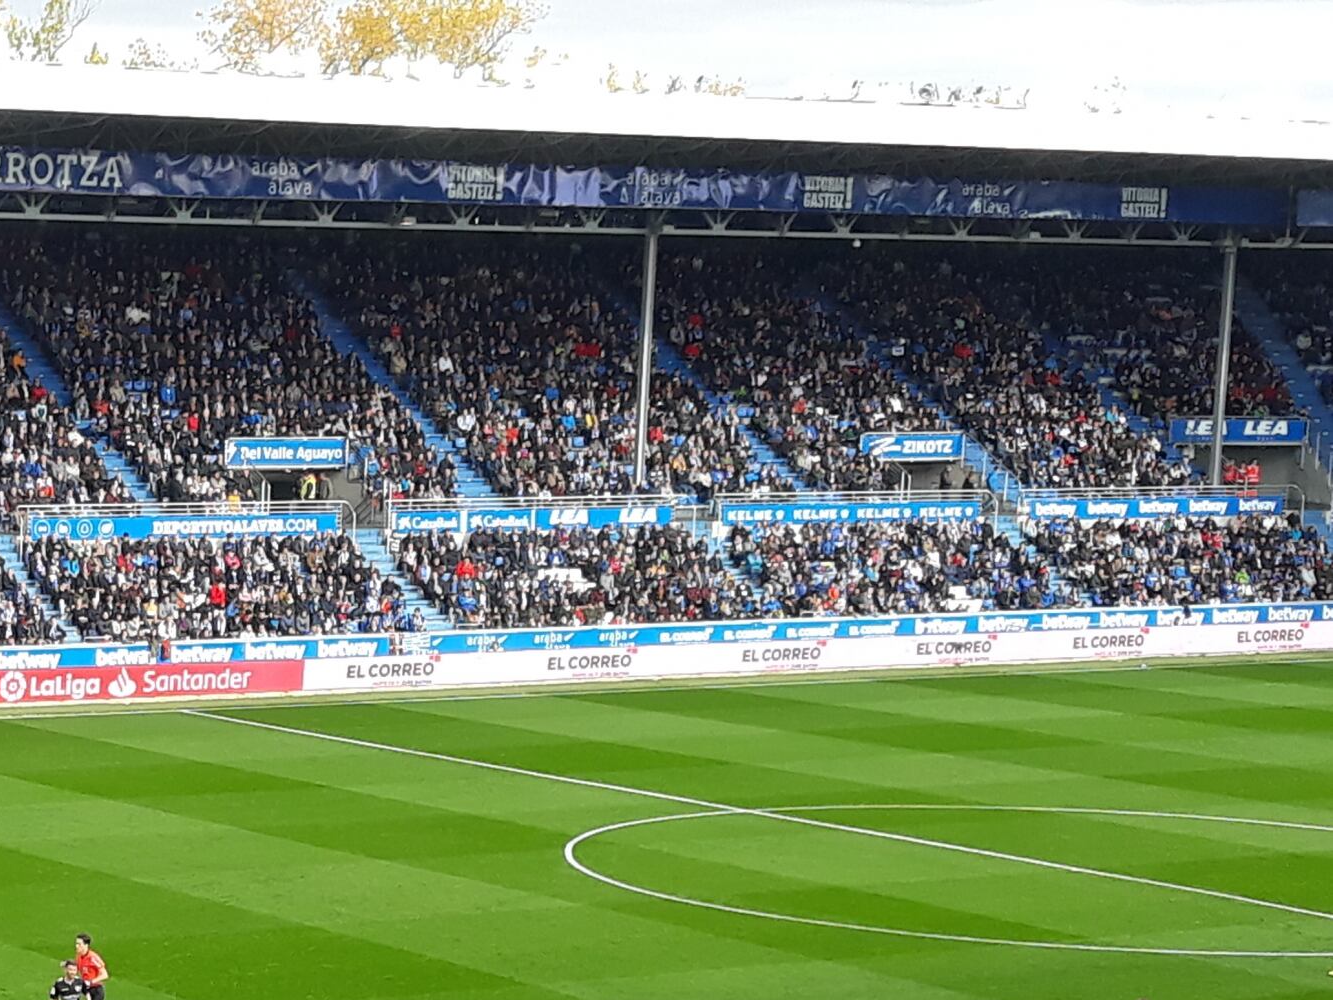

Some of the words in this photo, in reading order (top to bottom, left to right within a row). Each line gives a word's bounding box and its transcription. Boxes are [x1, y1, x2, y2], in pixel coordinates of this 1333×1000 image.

[1243, 420, 1288, 436] LEA
[240, 446, 261, 460] Del
[263, 446, 294, 460] Valle
[296, 447, 343, 463] Aguayo
[902, 439, 954, 454] ZIKOTZ
[1268, 606, 1314, 622] betway
[1073, 637, 1088, 650] EL
[1091, 635, 1143, 648] CORREO
[1238, 631, 1251, 643] EL
[1254, 629, 1303, 642] CORREO
[317, 641, 378, 659] betway
[743, 650, 758, 662] EL
[763, 647, 821, 661] CORREO
[917, 643, 932, 655] EL
[347, 664, 364, 679] EL
[369, 662, 434, 678] CORREO
[547, 657, 564, 671] EL
[568, 655, 631, 670] CORREO
[30, 674, 101, 699] LaLiga
[142, 669, 252, 694] Santander
